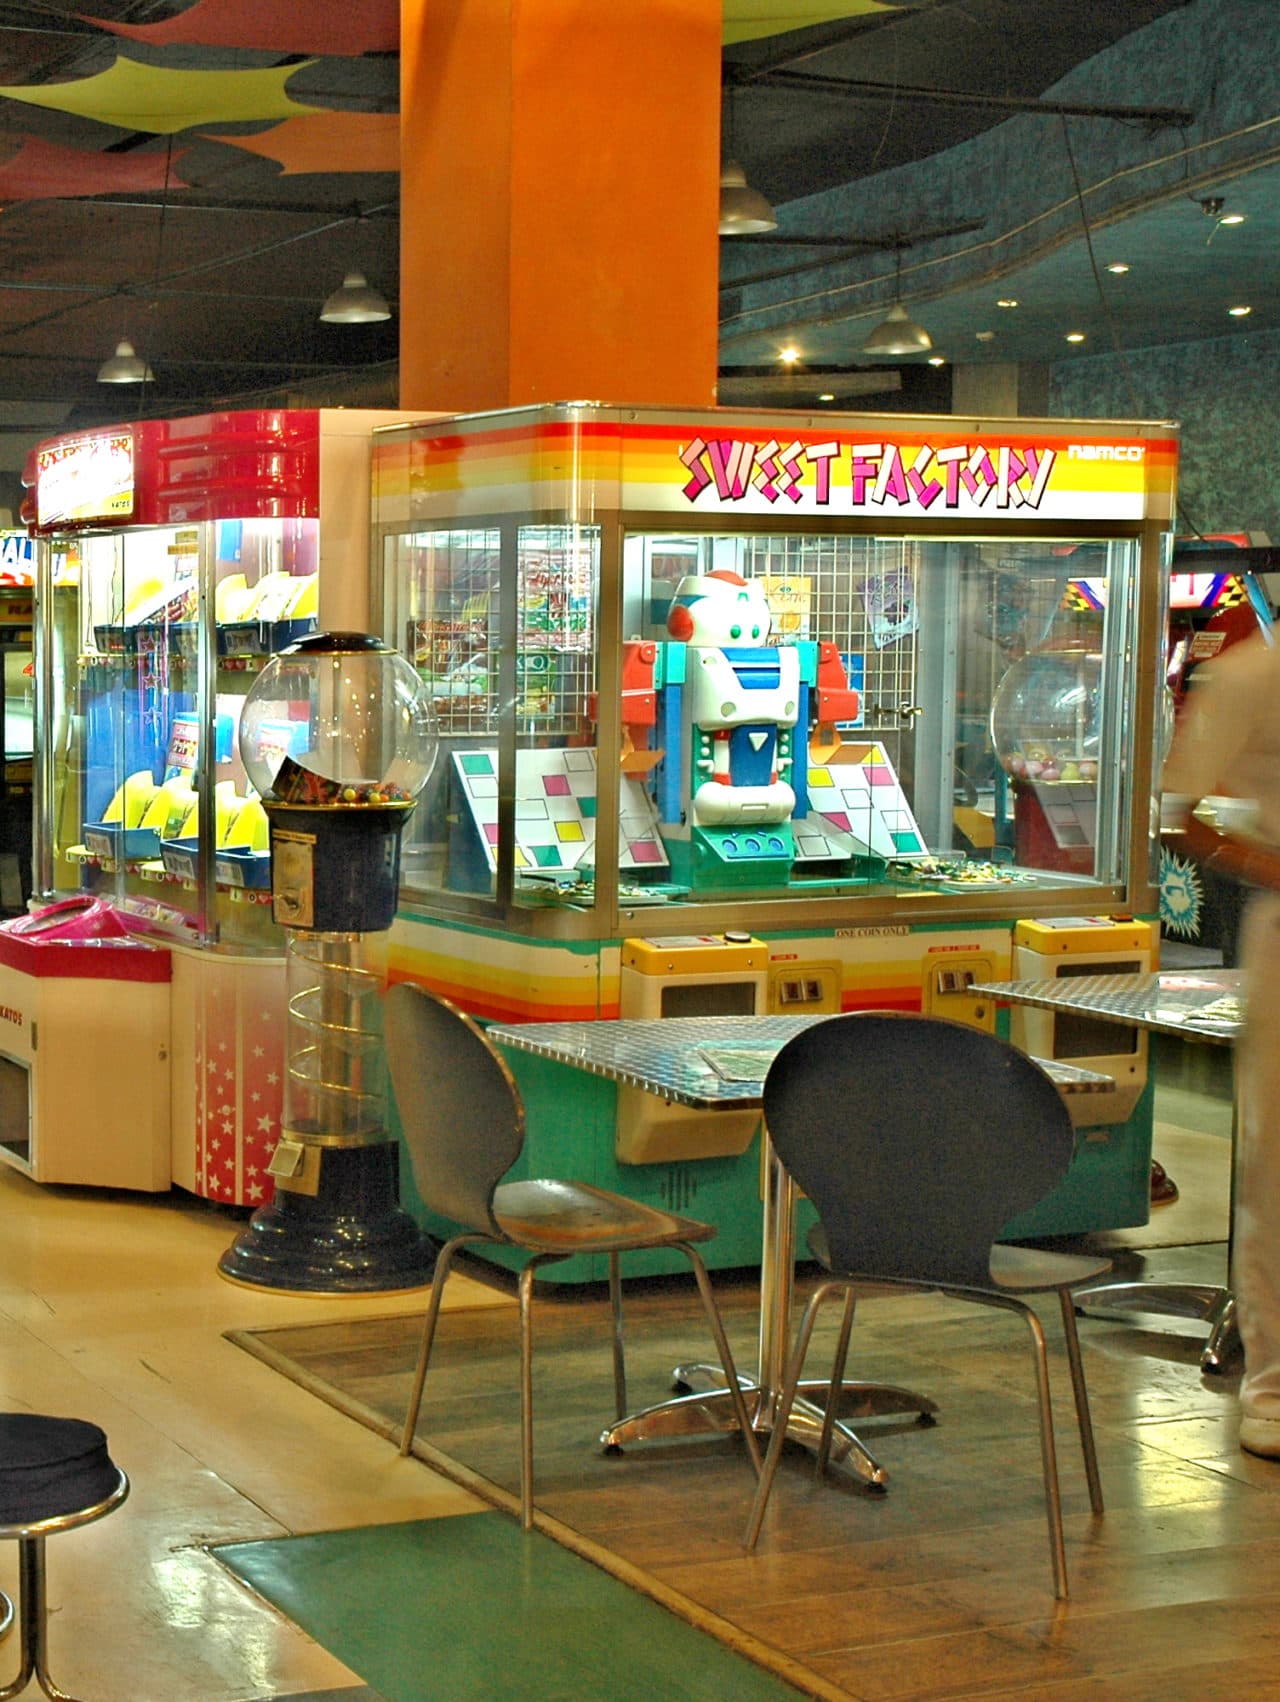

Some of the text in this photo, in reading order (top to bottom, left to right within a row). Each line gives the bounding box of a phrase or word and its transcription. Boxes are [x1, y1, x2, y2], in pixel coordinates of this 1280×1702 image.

[1067, 444, 1145, 463] namco
[678, 436, 1058, 511] SWEET FACTORY
[837, 926, 908, 938] ONE COIN ONLY
[0, 1004, 23, 1027] KATOS
